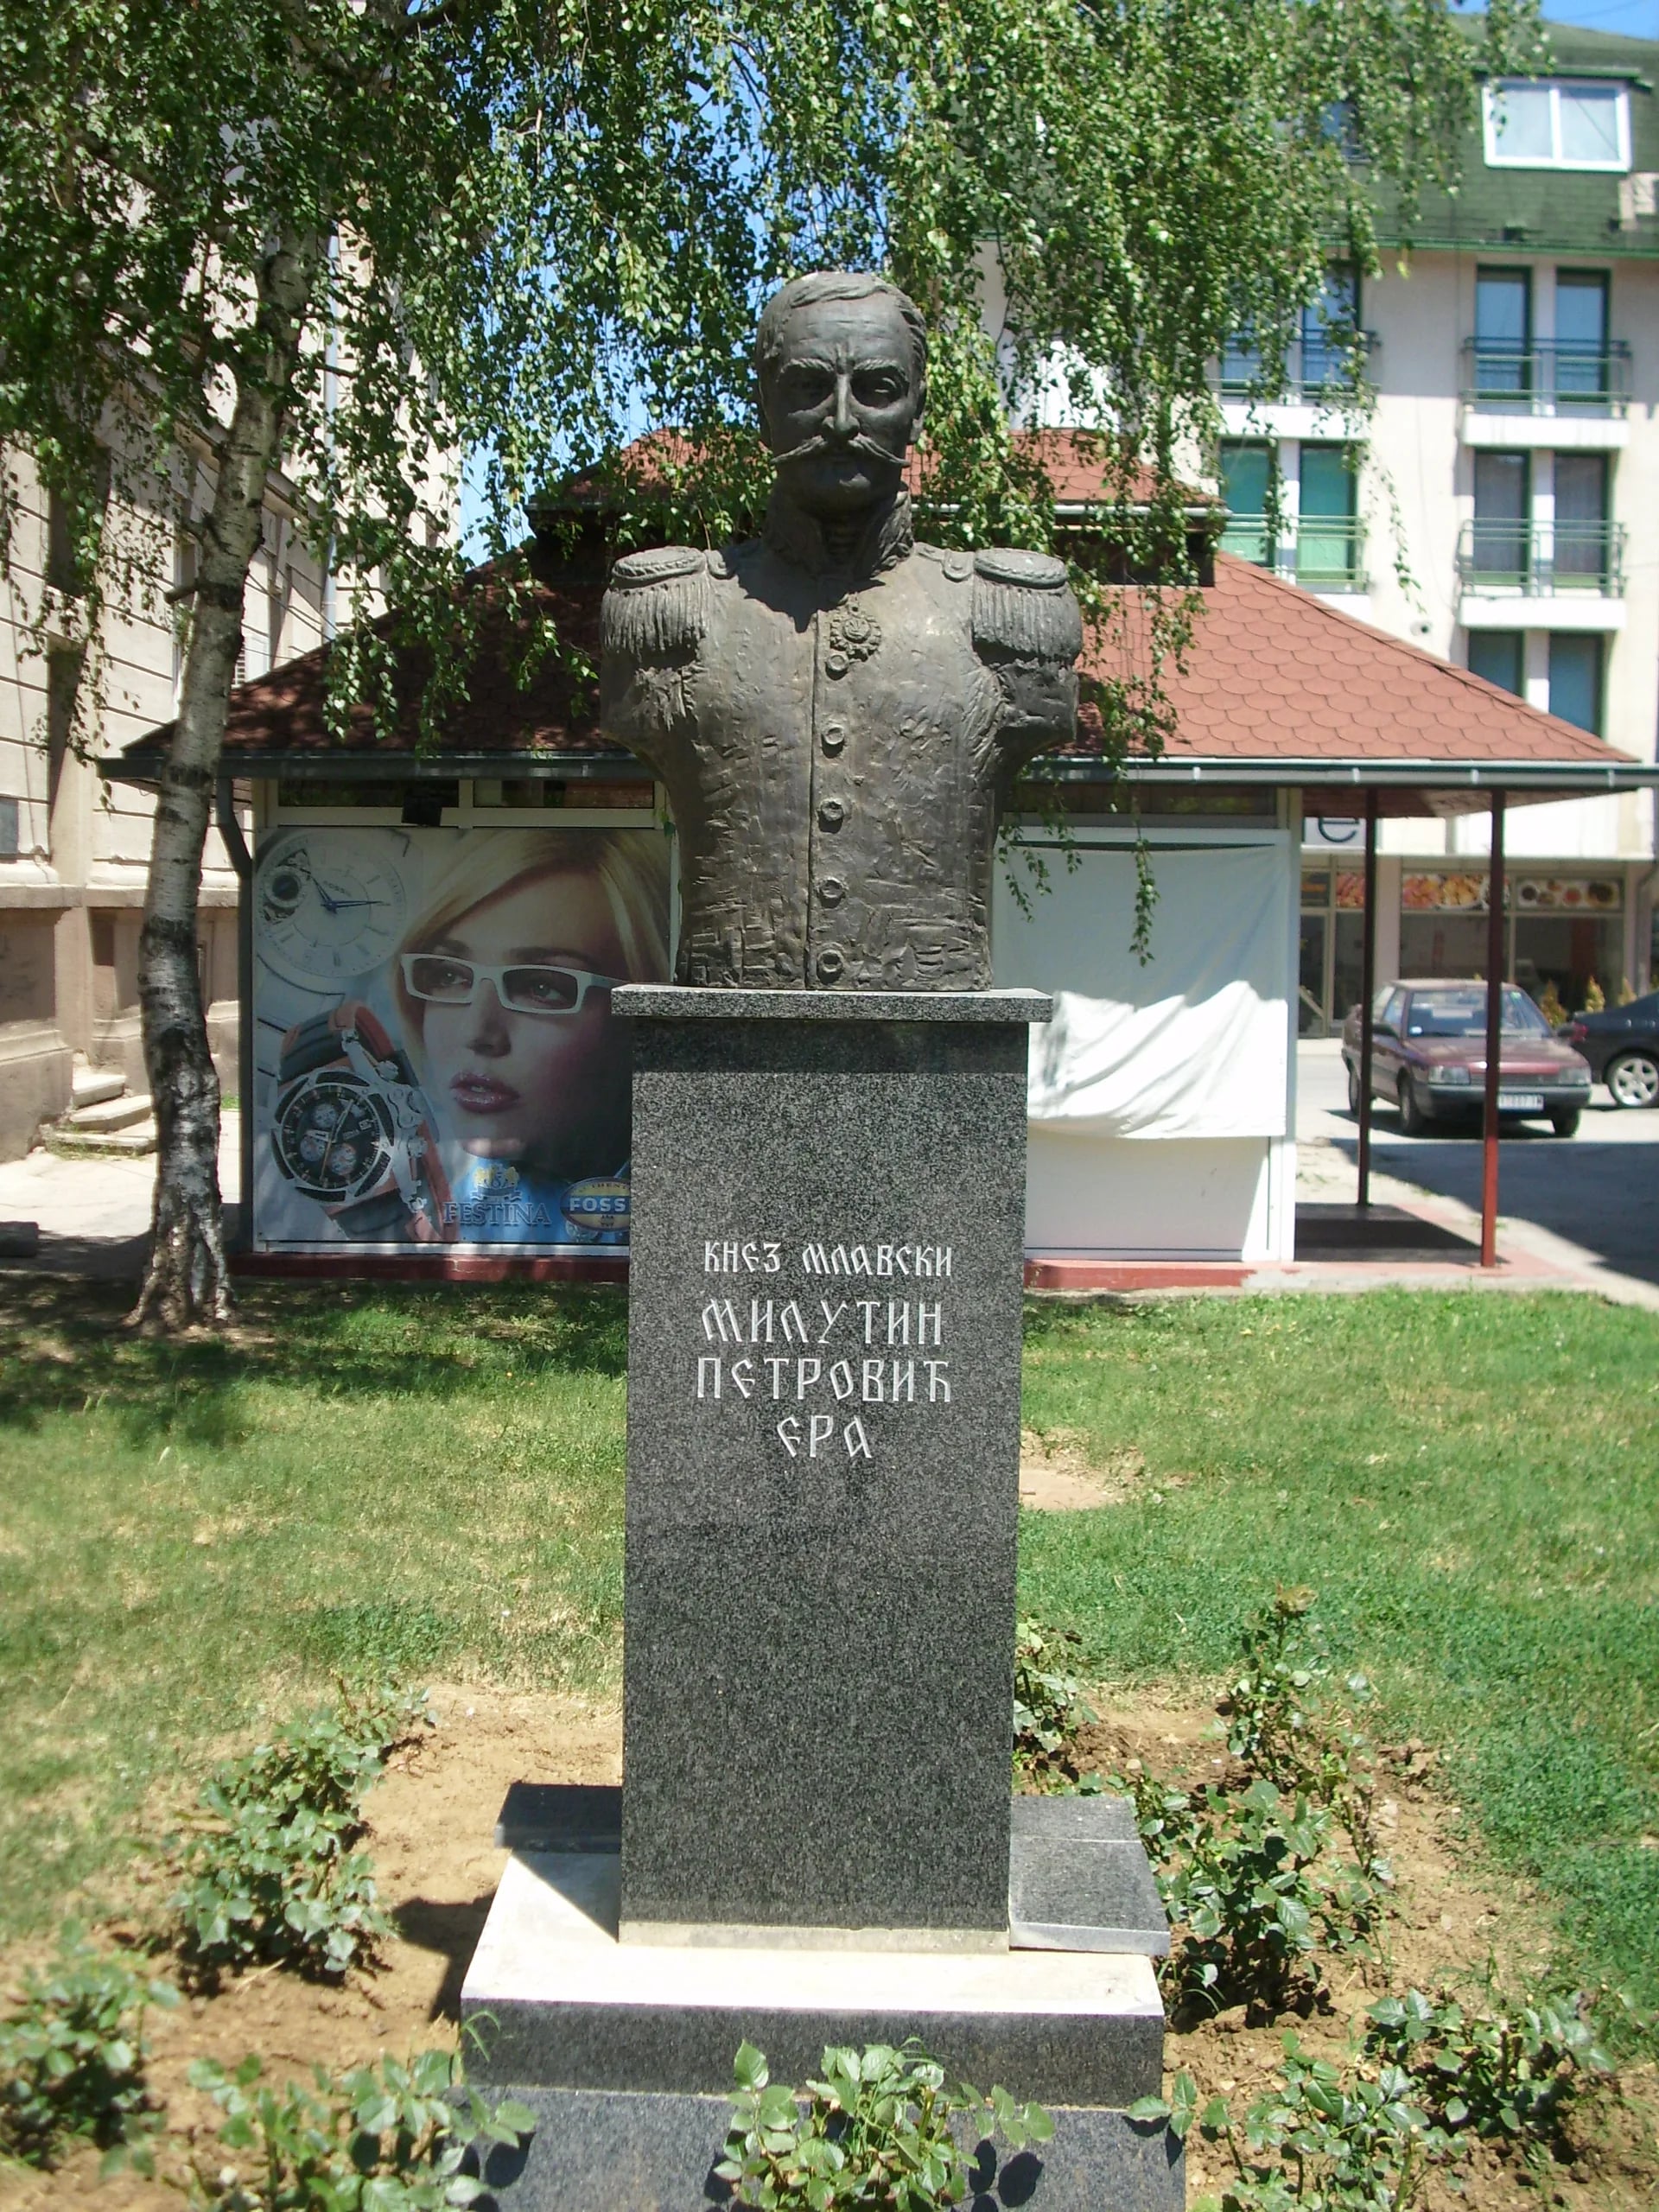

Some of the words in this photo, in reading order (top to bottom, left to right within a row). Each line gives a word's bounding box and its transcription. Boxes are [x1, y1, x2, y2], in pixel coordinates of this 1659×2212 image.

[442, 1202, 552, 1226] FESTINA
[569, 1198, 626, 1212] FOSS
[704, 1242, 781, 1273] КНЕЗ
[802, 1243, 951, 1276] МЛАВСКИ
[702, 1299, 942, 1344] МИЛУТИН
[697, 1357, 950, 1402] ПЕТРОВИЋ
[777, 1414, 872, 1458] ЕРА
